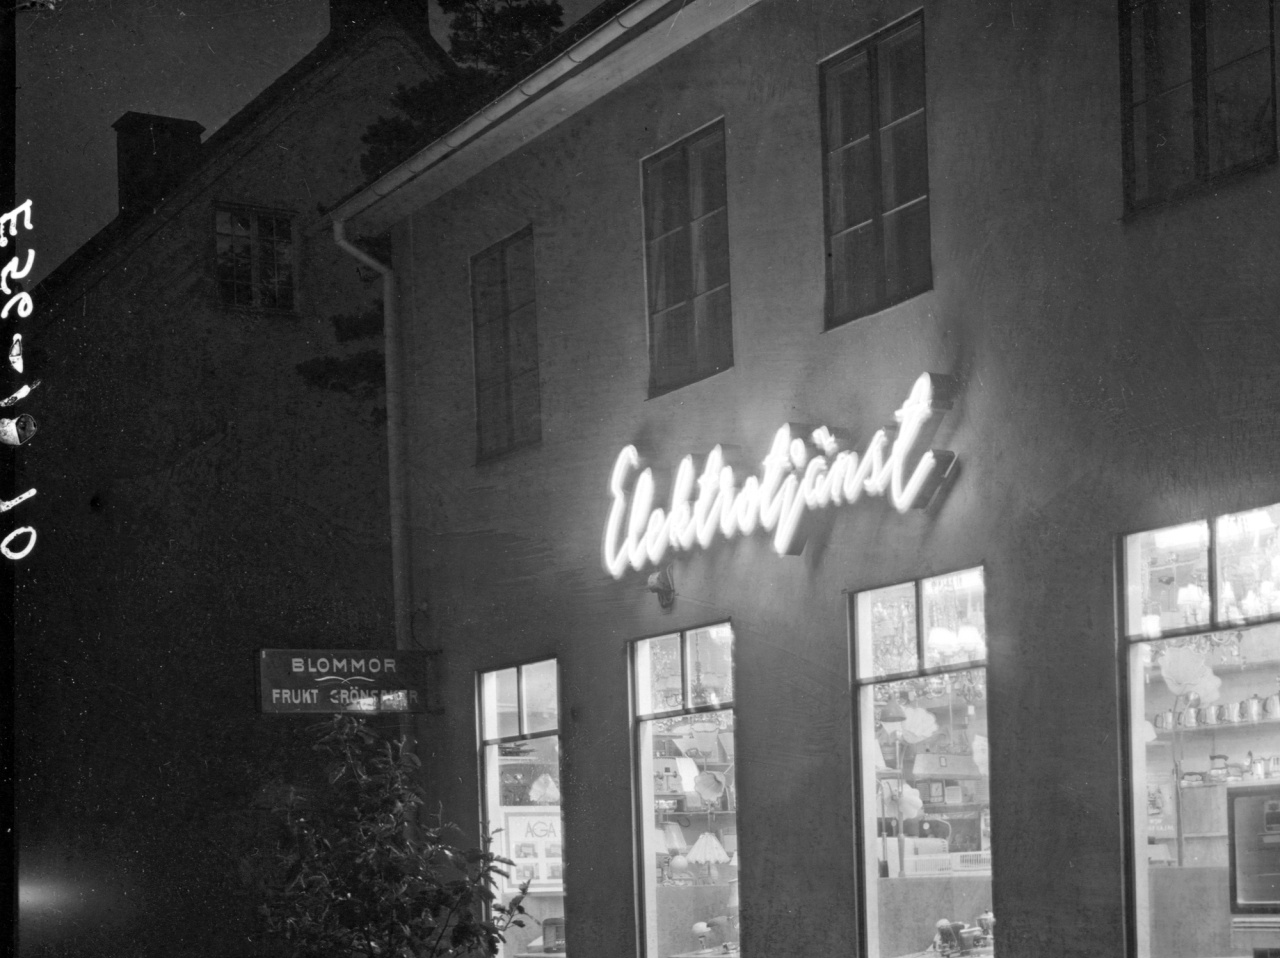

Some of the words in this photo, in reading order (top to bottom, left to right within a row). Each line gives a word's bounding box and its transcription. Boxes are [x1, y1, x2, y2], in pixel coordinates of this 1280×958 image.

[605, 371, 937, 580] Elektrotjänst
[291, 657, 397, 673] BLOMMOR
[272, 688, 319, 704] FRUKT
[524, 820, 557, 838] AGA
